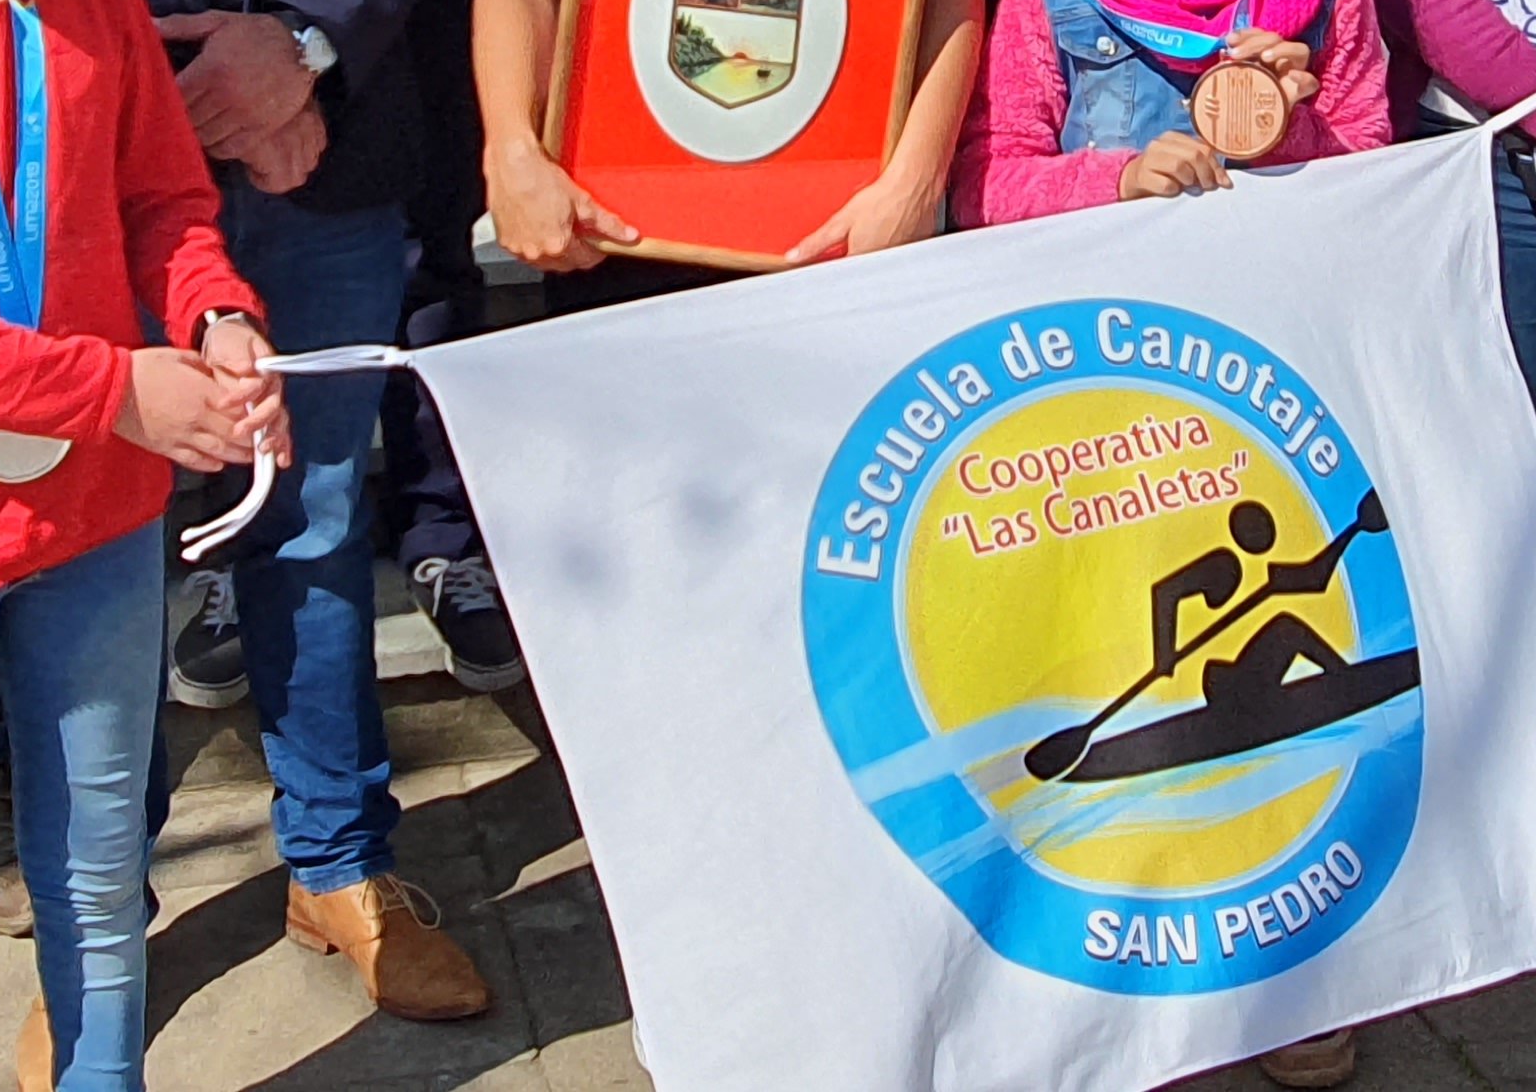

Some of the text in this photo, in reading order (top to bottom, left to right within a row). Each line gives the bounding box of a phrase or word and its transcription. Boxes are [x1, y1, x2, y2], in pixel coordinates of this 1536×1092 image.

[817, 308, 1341, 581] Escuela de Canotaje
[959, 412, 1210, 495] Cooperativa
[1083, 840, 1362, 964] SAN PEDRO
